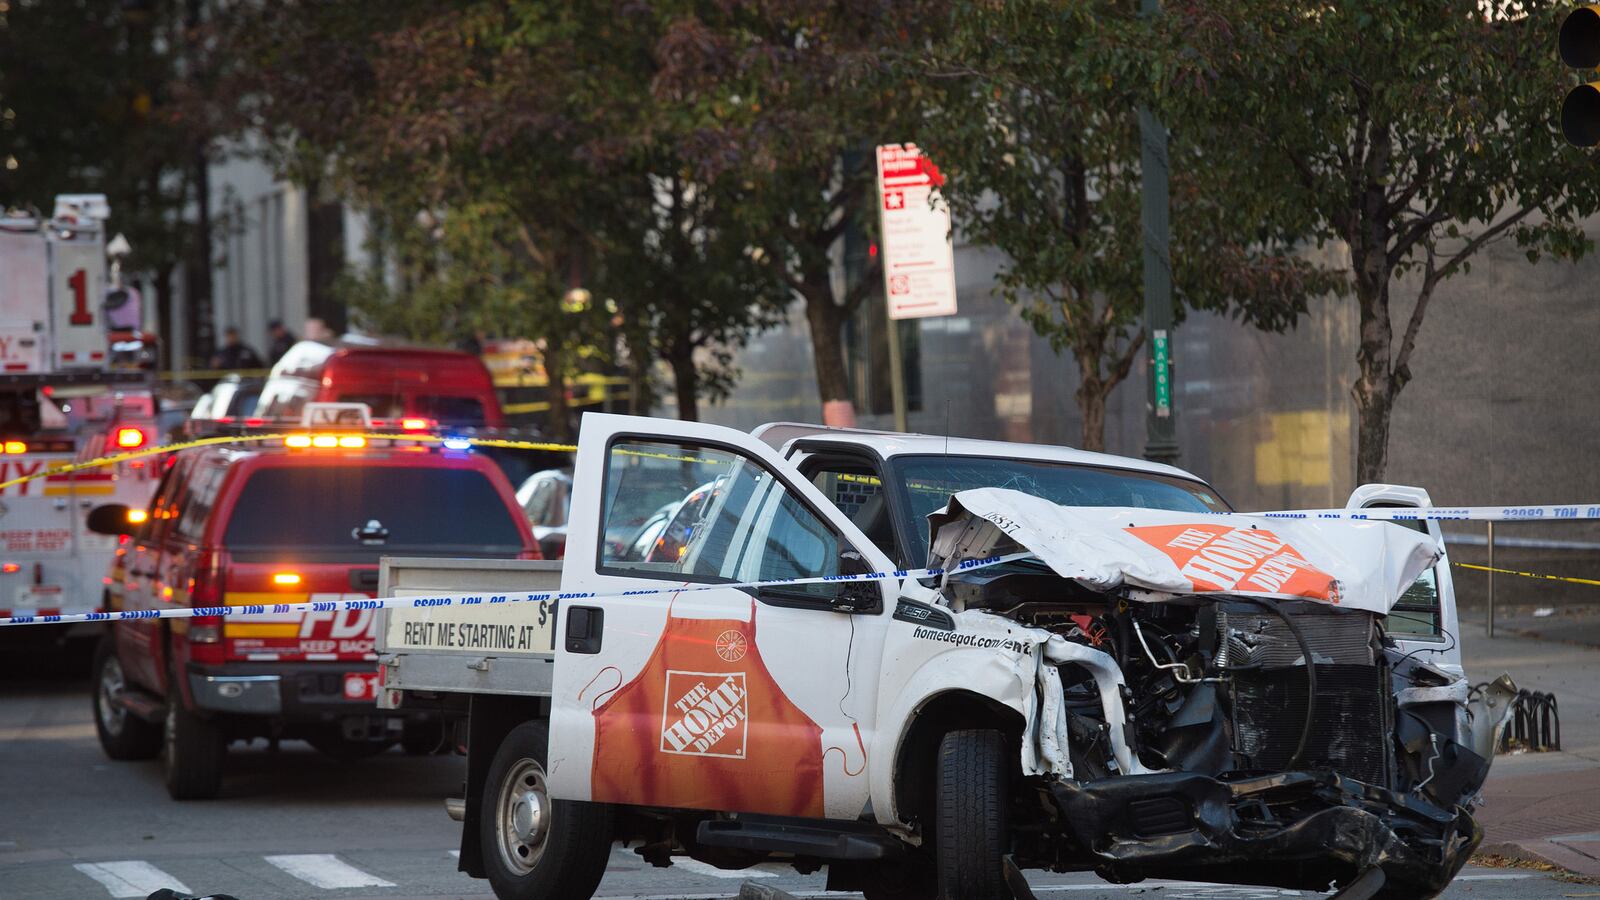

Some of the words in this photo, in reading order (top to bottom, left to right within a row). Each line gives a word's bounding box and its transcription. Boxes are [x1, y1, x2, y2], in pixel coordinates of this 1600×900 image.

[68, 268, 93, 327] 1
[1167, 528, 1217, 551] THE
[1180, 528, 1283, 591] HOME
[1247, 551, 1312, 593] DEPT
[300, 640, 337, 653] KEEP
[404, 622, 435, 646] RENT
[437, 623, 455, 647] ME
[458, 623, 515, 649] STARTING
[518, 625, 534, 650] AT
[663, 675, 746, 753] HOME
[674, 681, 711, 714] THE
[693, 704, 746, 754] DEPOT
